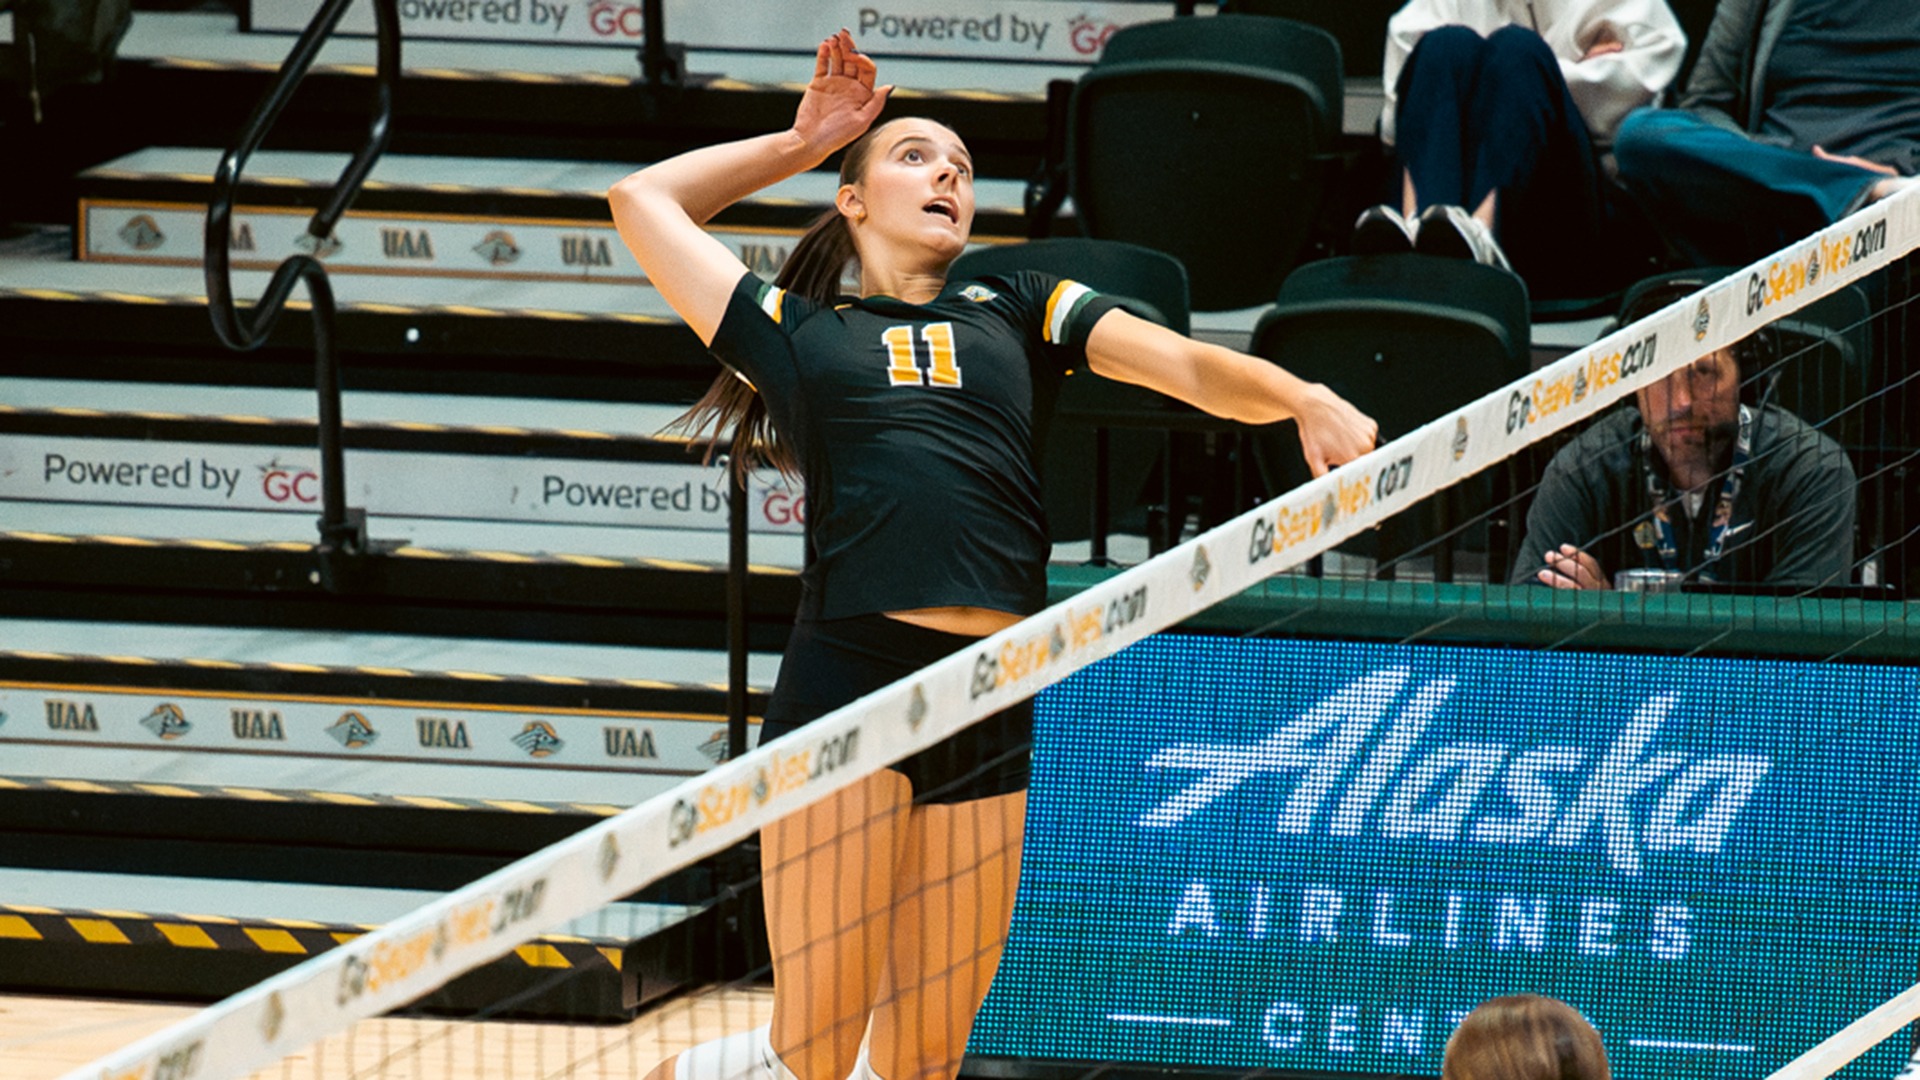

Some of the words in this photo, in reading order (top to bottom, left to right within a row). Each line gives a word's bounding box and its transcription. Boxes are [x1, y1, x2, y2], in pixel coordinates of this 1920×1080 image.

[400, 0, 522, 24] owered
[530, 0, 567, 31] by
[859, 8, 1002, 42] Powered
[1011, 15, 1049, 50] by
[381, 226, 434, 260] UAA
[560, 235, 613, 267] UAA
[881, 321, 962, 389] 11
[44, 454, 191, 489] Powered
[202, 459, 240, 498] by
[543, 475, 692, 512] Powered
[44, 700, 101, 733] UAA
[230, 708, 288, 742] UAA
[416, 718, 473, 750] UAA
[603, 727, 660, 760] UAA
[1133, 664, 1773, 876] Alaska
[1167, 878, 1693, 961] AIRLINES
